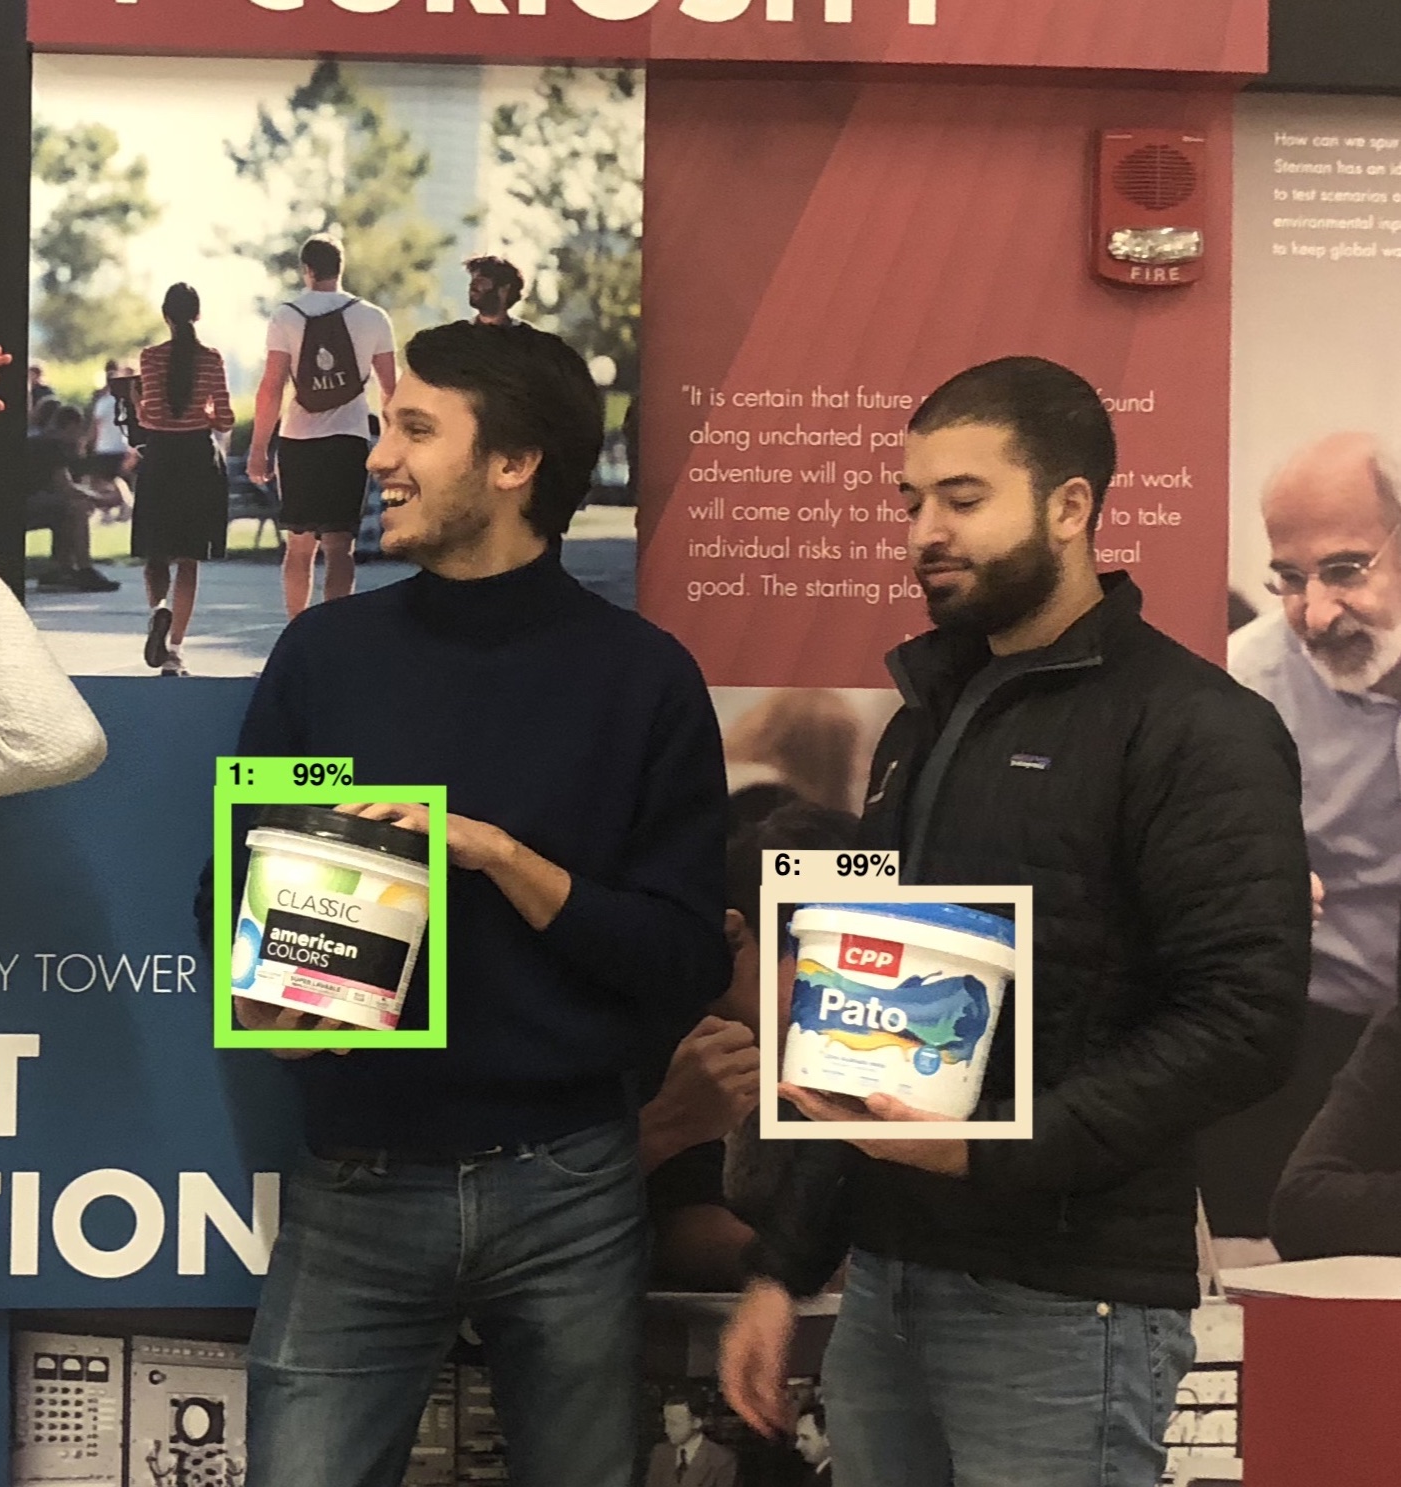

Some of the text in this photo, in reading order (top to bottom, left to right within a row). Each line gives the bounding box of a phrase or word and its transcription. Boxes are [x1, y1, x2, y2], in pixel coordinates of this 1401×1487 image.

[1274, 132, 1308, 146] How
[1312, 136, 1338, 147] can
[1344, 137, 1365, 147] we
[1336, 160, 1362, 174] has
[1367, 165, 1385, 175] an
[1273, 188, 1287, 200] to
[1292, 189, 1316, 201] test
[1320, 189, 1387, 203] scenarios
[1272, 214, 1374, 229] environmental
[1272, 243, 1286, 255] to
[1292, 241, 1326, 259] keep
[1330, 242, 1376, 260] global
[1130, 267, 1180, 281] FIRE
[312, 371, 346, 390] MIT
[710, 388, 726, 407] is
[732, 388, 803, 408] certain
[812, 385, 849, 408] that
[857, 385, 913, 409] future
[1099, 388, 1155, 412] ound
[689, 421, 907, 452] along uncharted pat
[689, 460, 793, 483] adventure
[800, 460, 835, 484] will
[844, 470, 872, 491] go
[1141, 466, 1193, 488] work
[687, 497, 724, 520] will
[732, 504, 790, 521] come
[797, 498, 842, 528] only
[849, 506, 869, 522] to
[876, 499, 911, 522] tho
[1111, 508, 1130, 525] to
[1138, 503, 1182, 525] take
[688, 535, 790, 559] individual
[798, 536, 842, 559] risks
[849, 539, 867, 559] in
[876, 537, 907, 561] the
[687, 573, 922, 604] good. The starting pla
[277, 888, 362, 923] CLASSIC
[267, 942, 330, 968] COLORS
[270, 927, 359, 959] american
[844, 947, 894, 969] CPP
[34, 953, 197, 993] TOWER
[818, 987, 908, 1033] Pato
